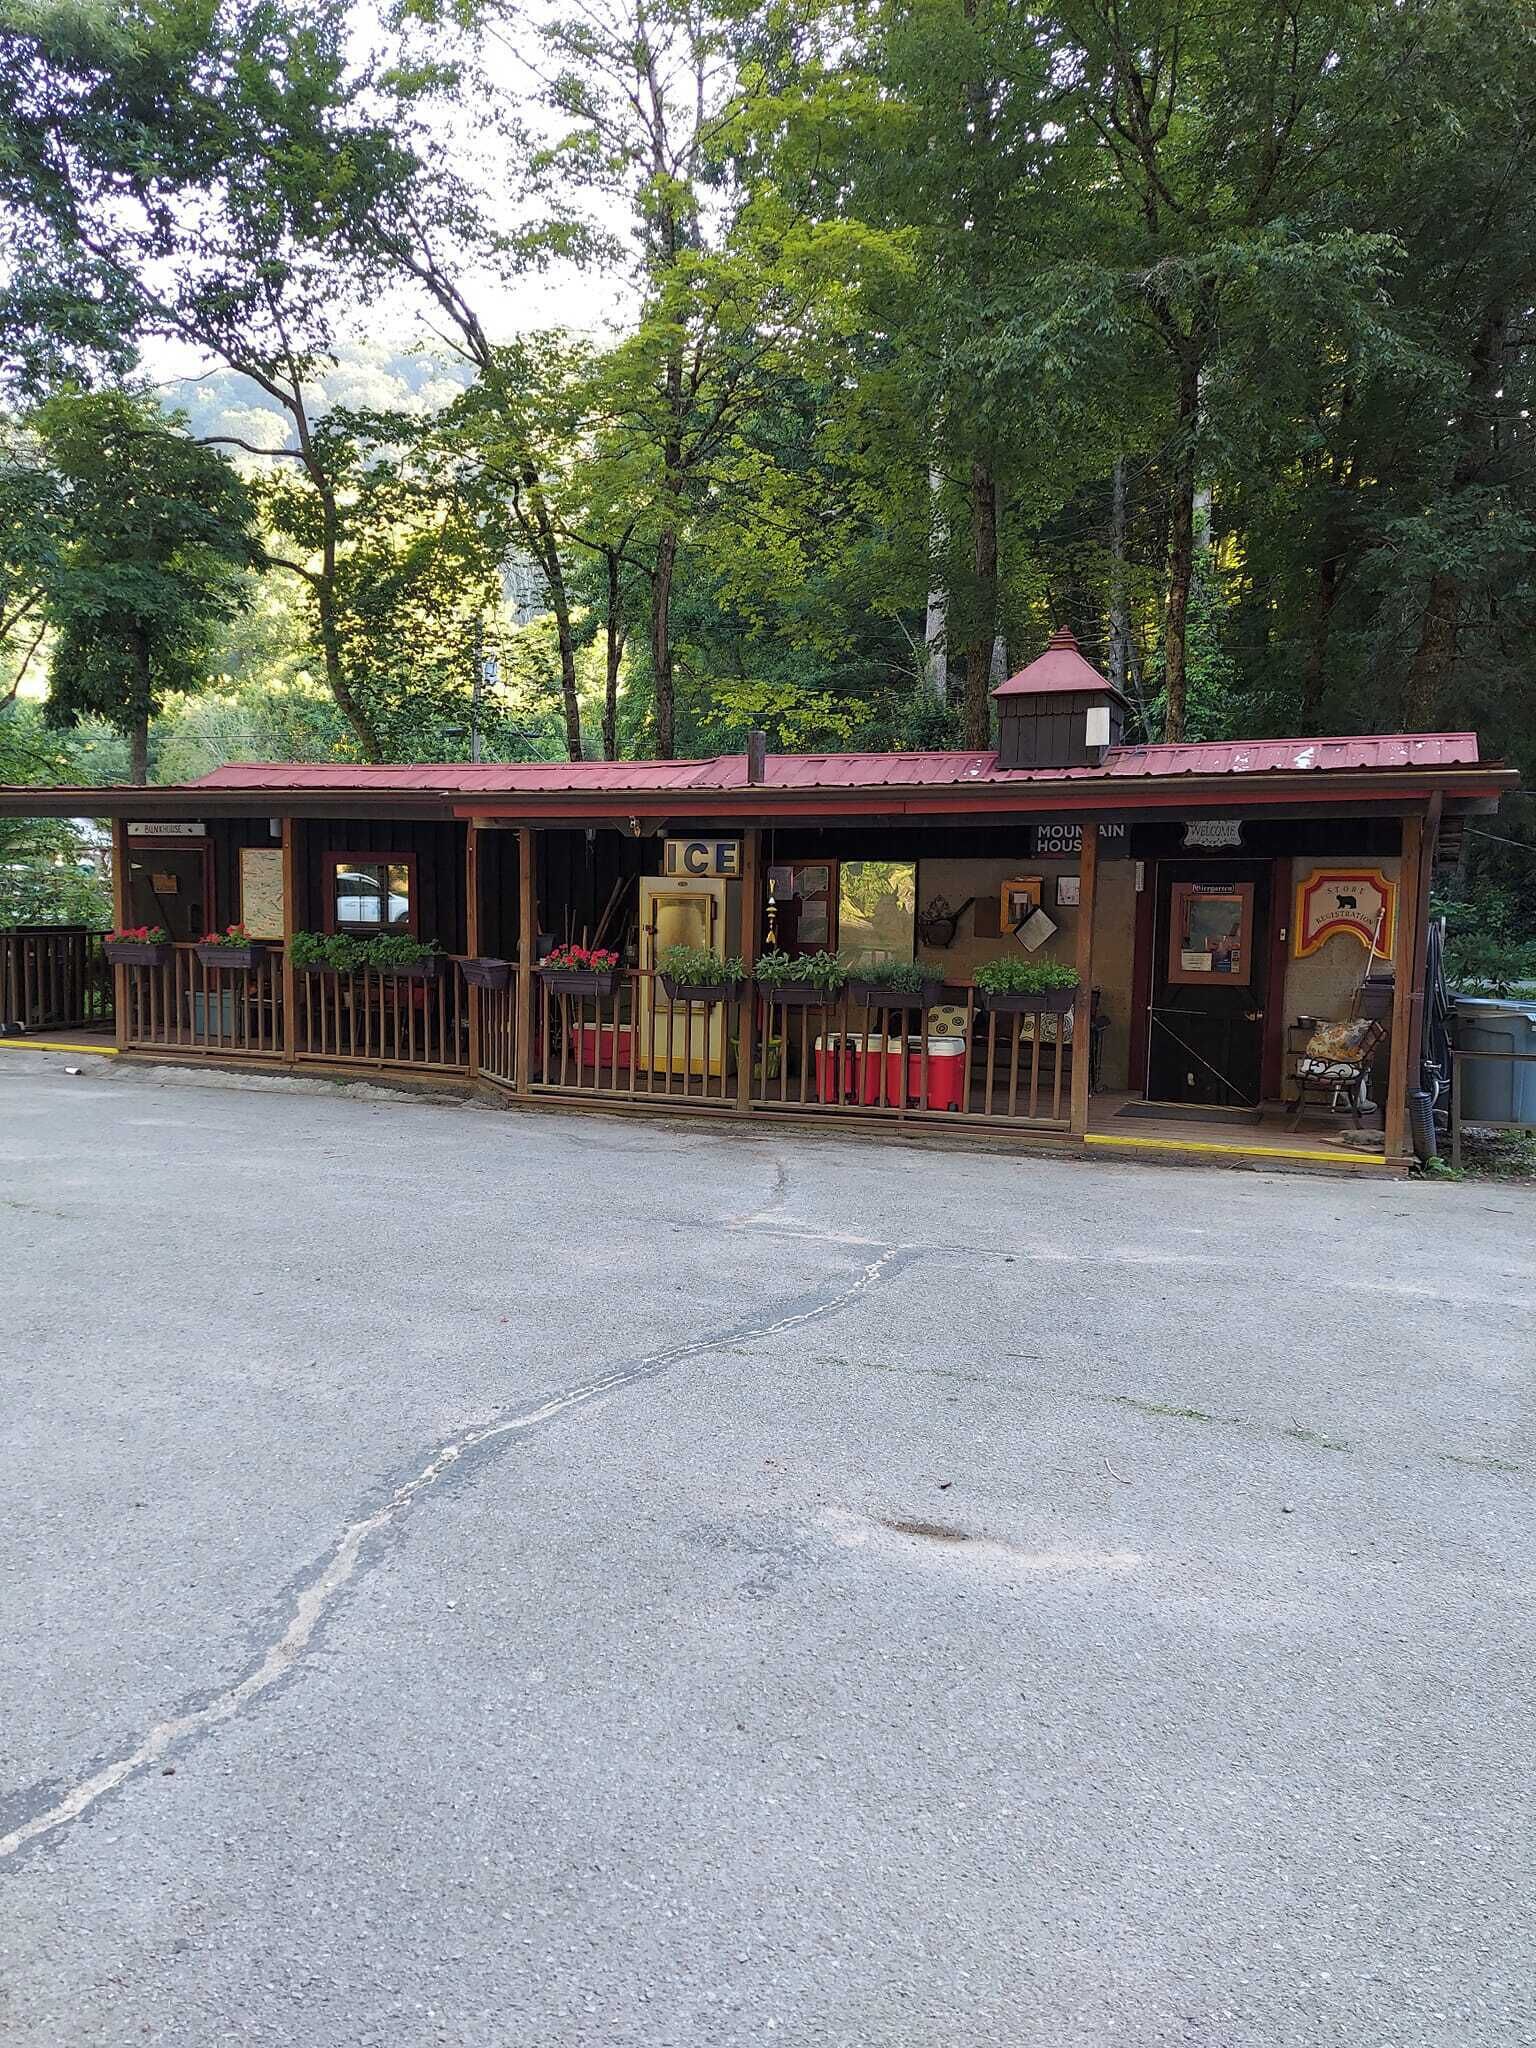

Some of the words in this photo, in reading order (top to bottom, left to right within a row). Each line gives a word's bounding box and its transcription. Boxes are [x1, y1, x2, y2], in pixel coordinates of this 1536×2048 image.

[1038, 824, 1125, 838] MOUNAIN
[1037, 839, 1083, 852] HOUS
[667, 843, 736, 873] ICE
[1327, 885, 1363, 895] STORE
[1315, 910, 1376, 926] REGISTRATION
